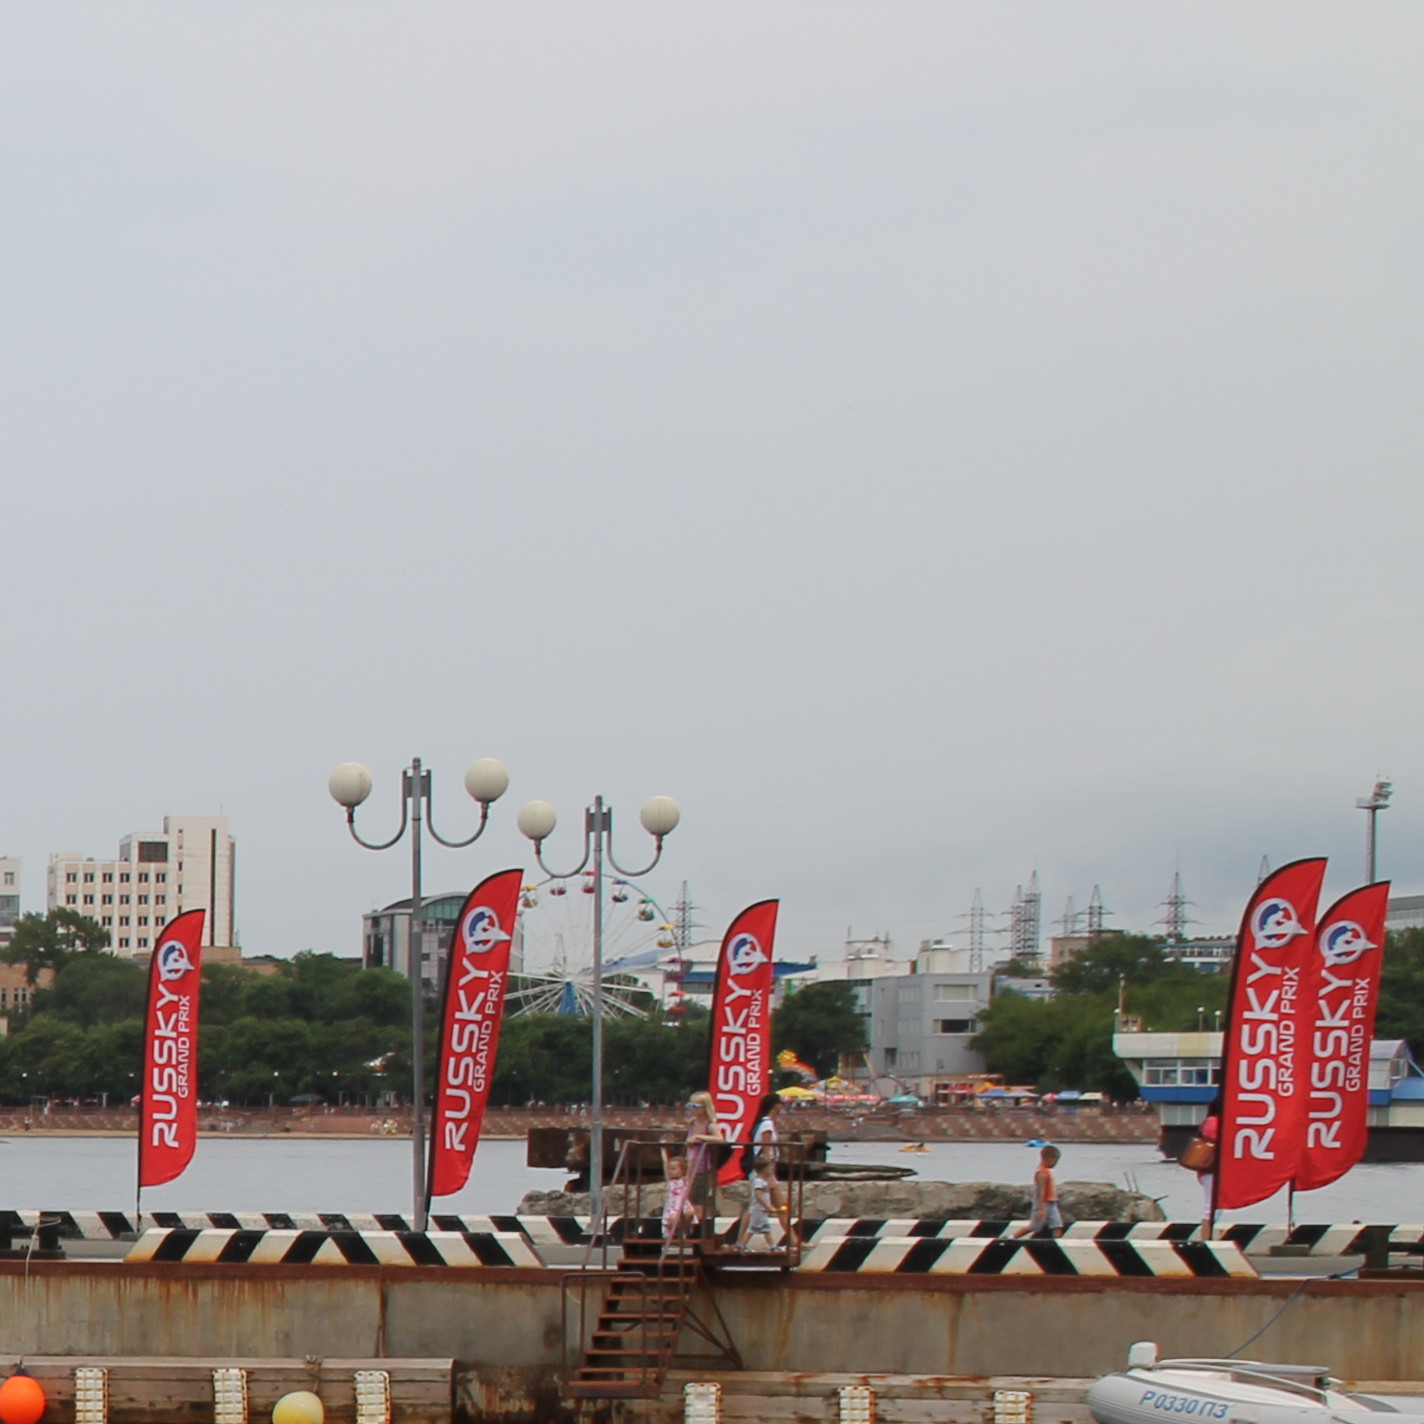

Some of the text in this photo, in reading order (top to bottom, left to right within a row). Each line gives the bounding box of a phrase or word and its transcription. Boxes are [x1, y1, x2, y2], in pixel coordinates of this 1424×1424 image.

[152, 983, 179, 1148] RUSSKY
[178, 995, 190, 1098] GRAND PRIX
[444, 957, 489, 1151] RUSSKY
[473, 970, 503, 1092] GRAND PRIX
[716, 978, 752, 1148] RUSSKY
[746, 989, 763, 1096] GRAND PRIX
[1234, 953, 1282, 1160] RUSSKY
[1278, 966, 1301, 1096] GRAND PRIX
[1307, 969, 1353, 1148] RUSSKY
[1345, 977, 1370, 1092] GRAND PRIX
